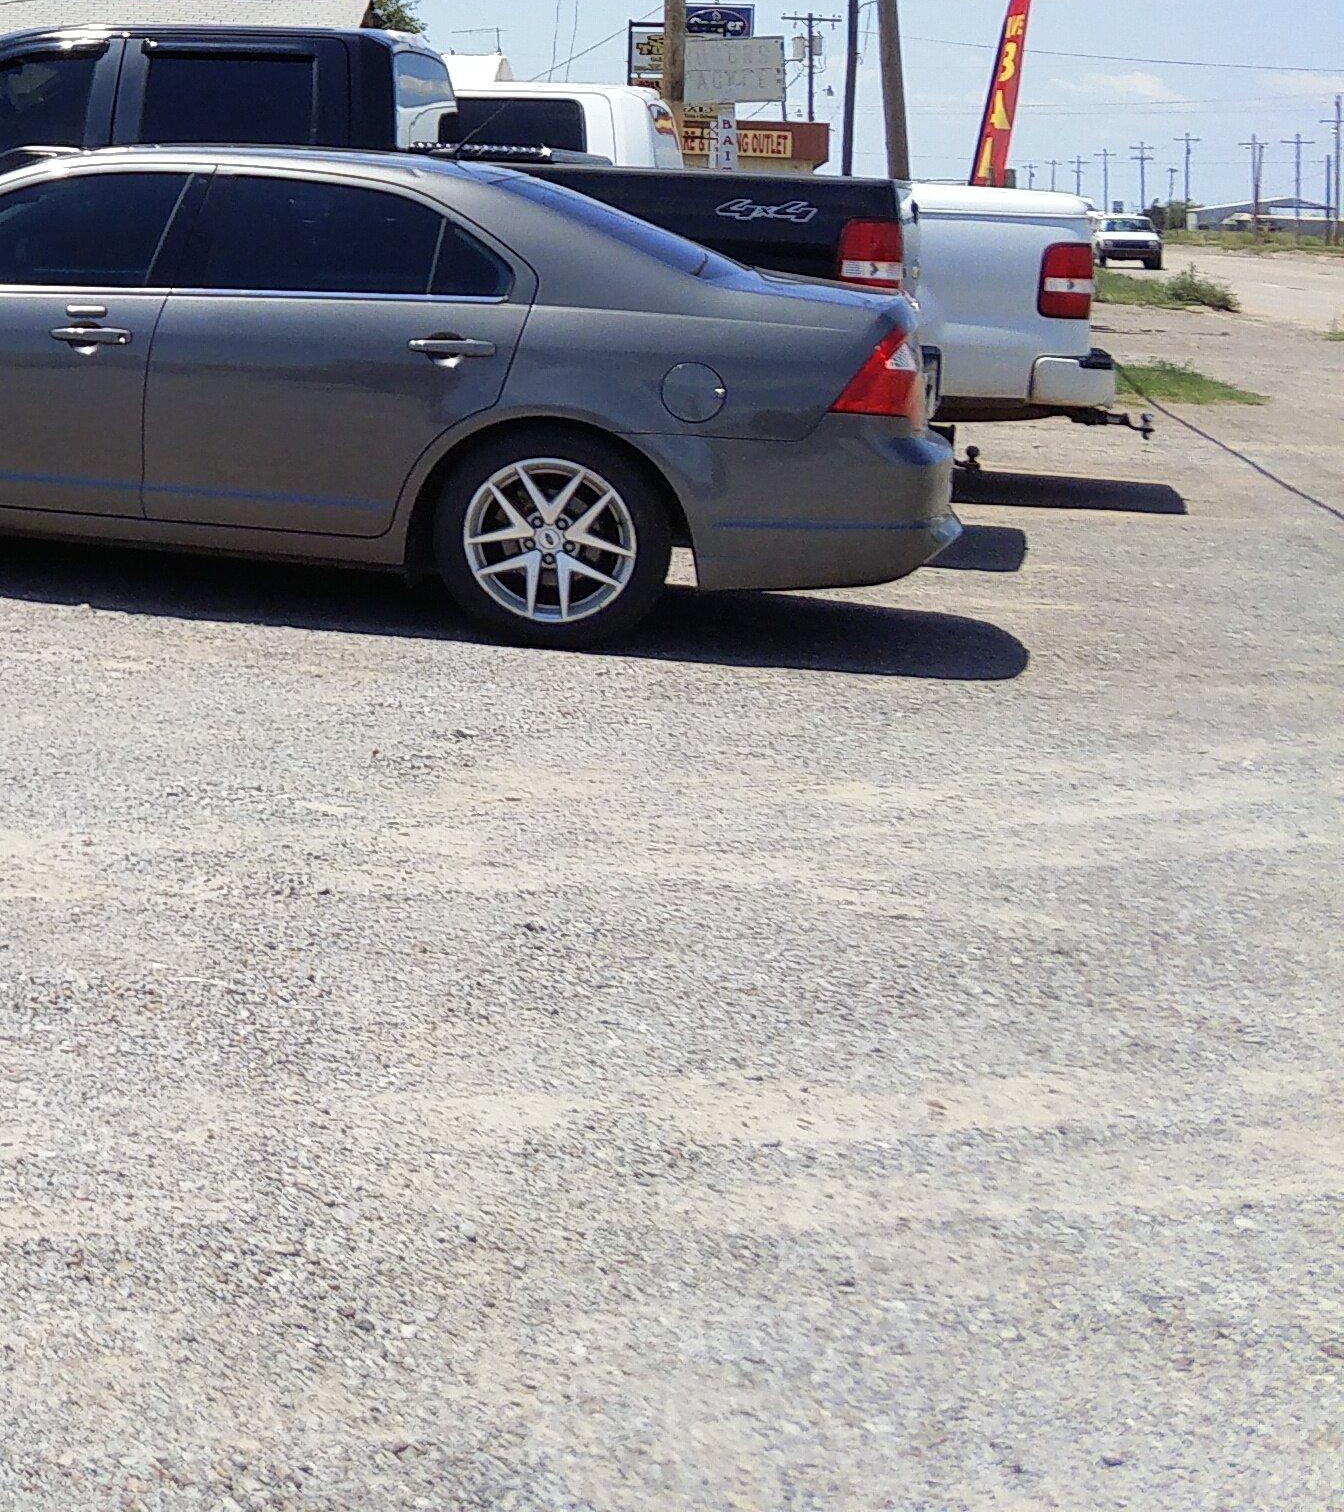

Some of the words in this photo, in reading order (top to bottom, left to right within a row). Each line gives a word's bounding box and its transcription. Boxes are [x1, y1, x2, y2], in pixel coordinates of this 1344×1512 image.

[722, 119, 734, 170] BAI
[752, 133, 789, 155] OUTLET
[715, 198, 818, 223] 4x4
